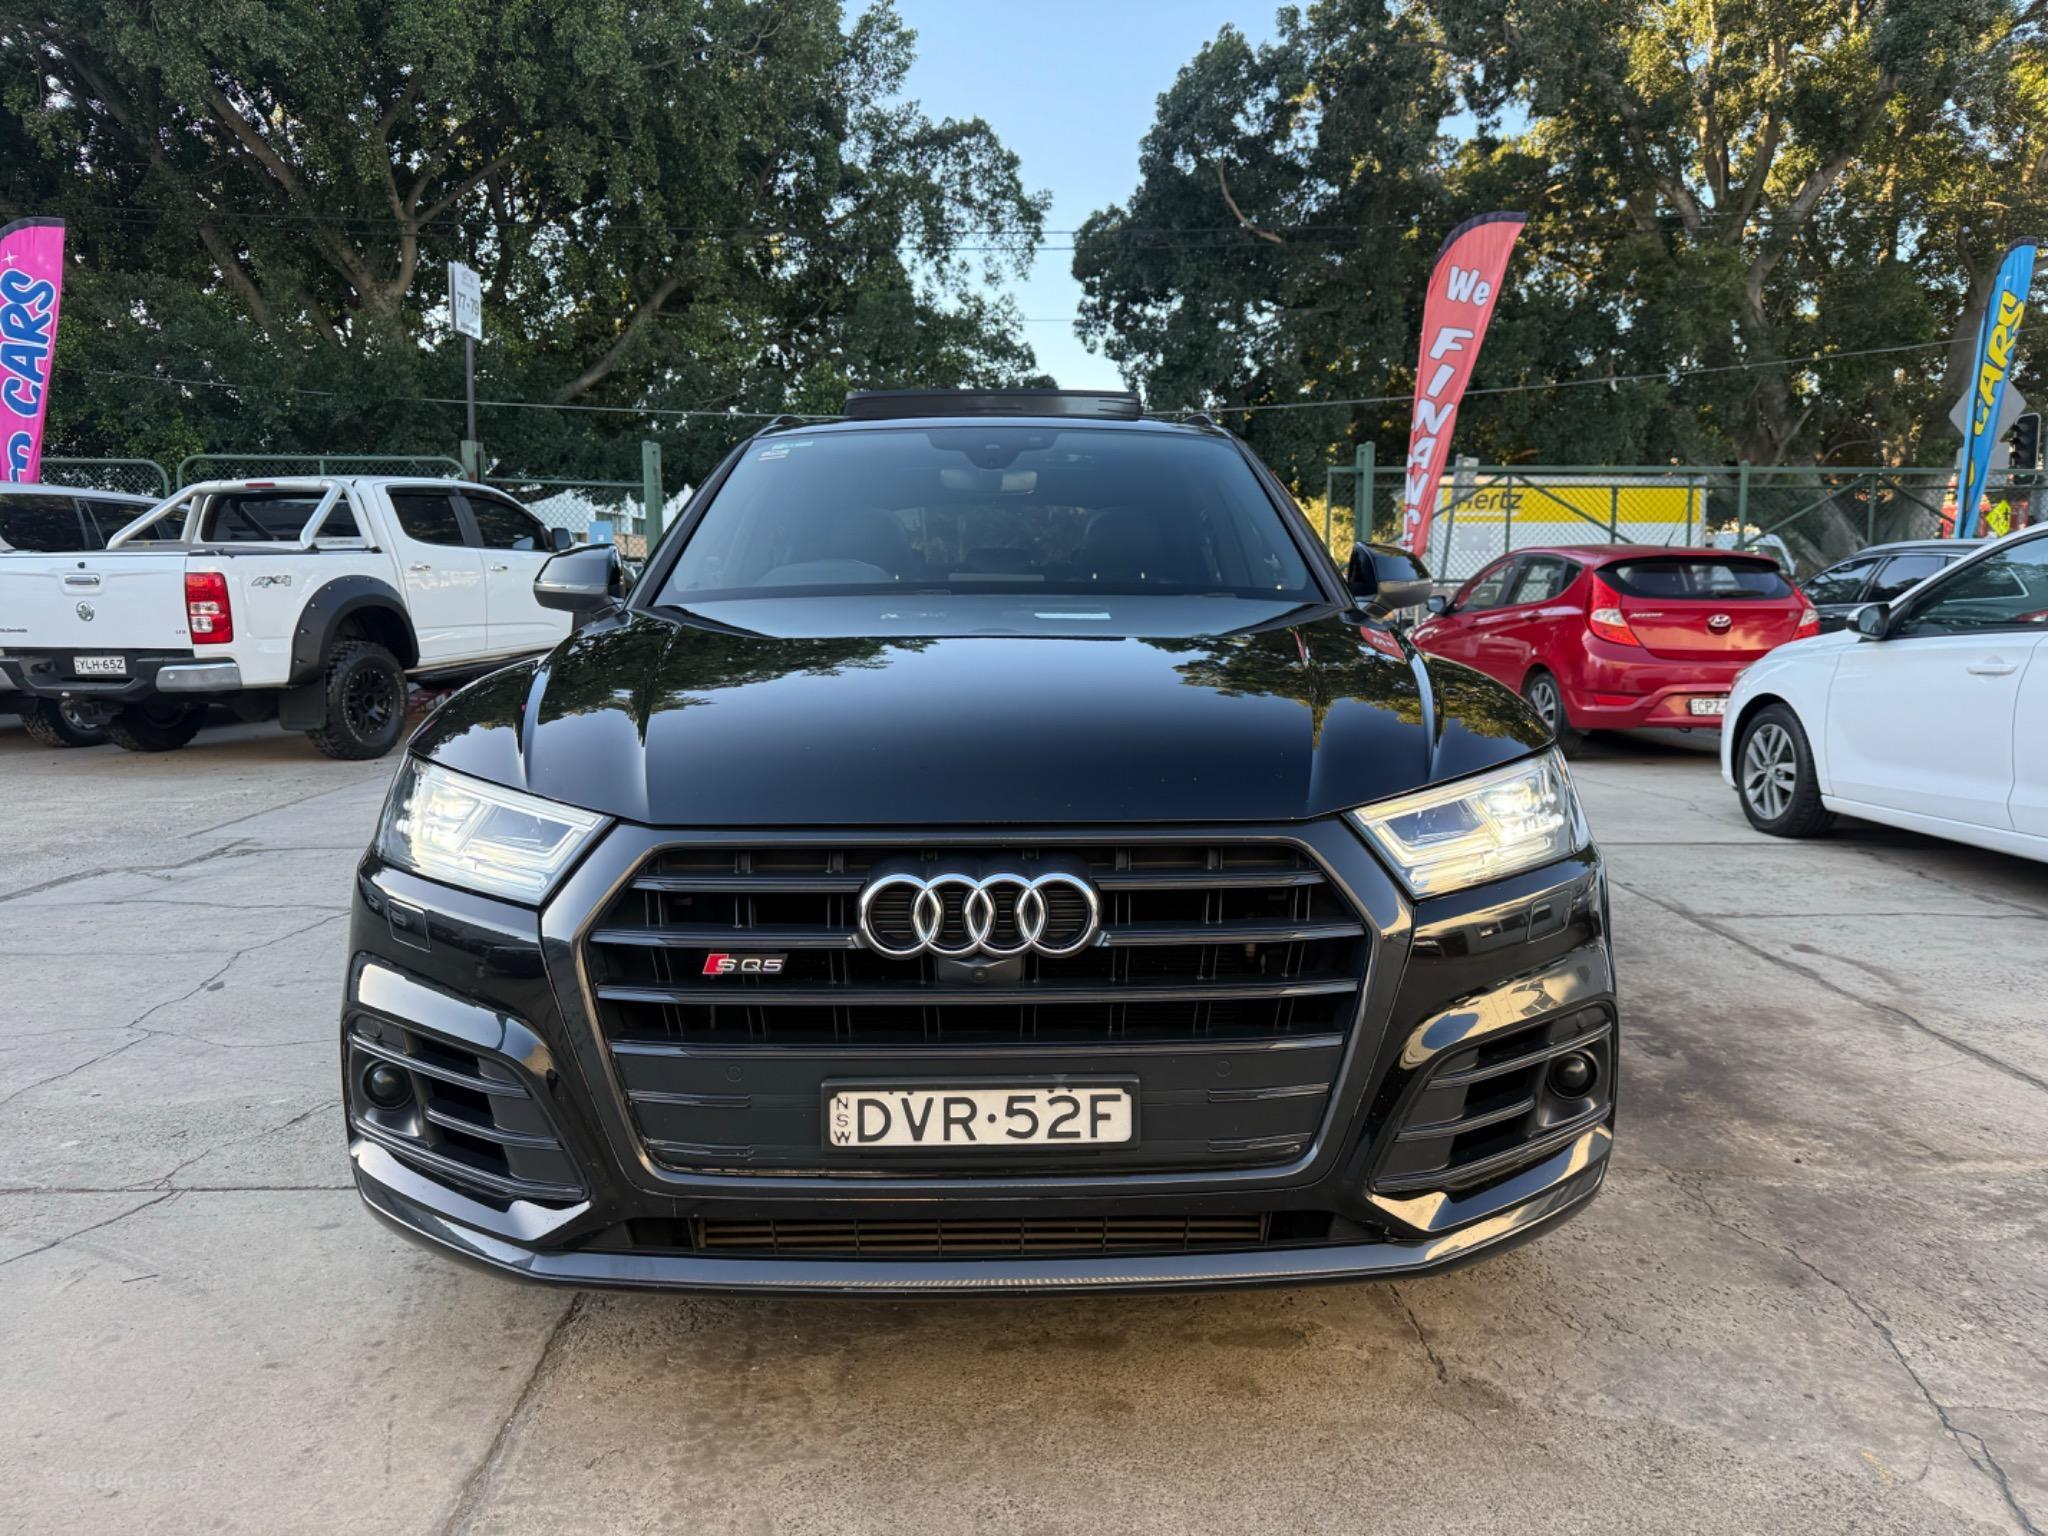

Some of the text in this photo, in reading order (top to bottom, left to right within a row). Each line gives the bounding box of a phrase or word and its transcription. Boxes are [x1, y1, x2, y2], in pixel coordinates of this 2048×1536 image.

[1445, 265, 1490, 306] We
[0, 268, 56, 418] CARS
[1974, 290, 2025, 437] CARS
[716, 958, 784, 973] SQ5
[834, 1096, 852, 1145] NSW
